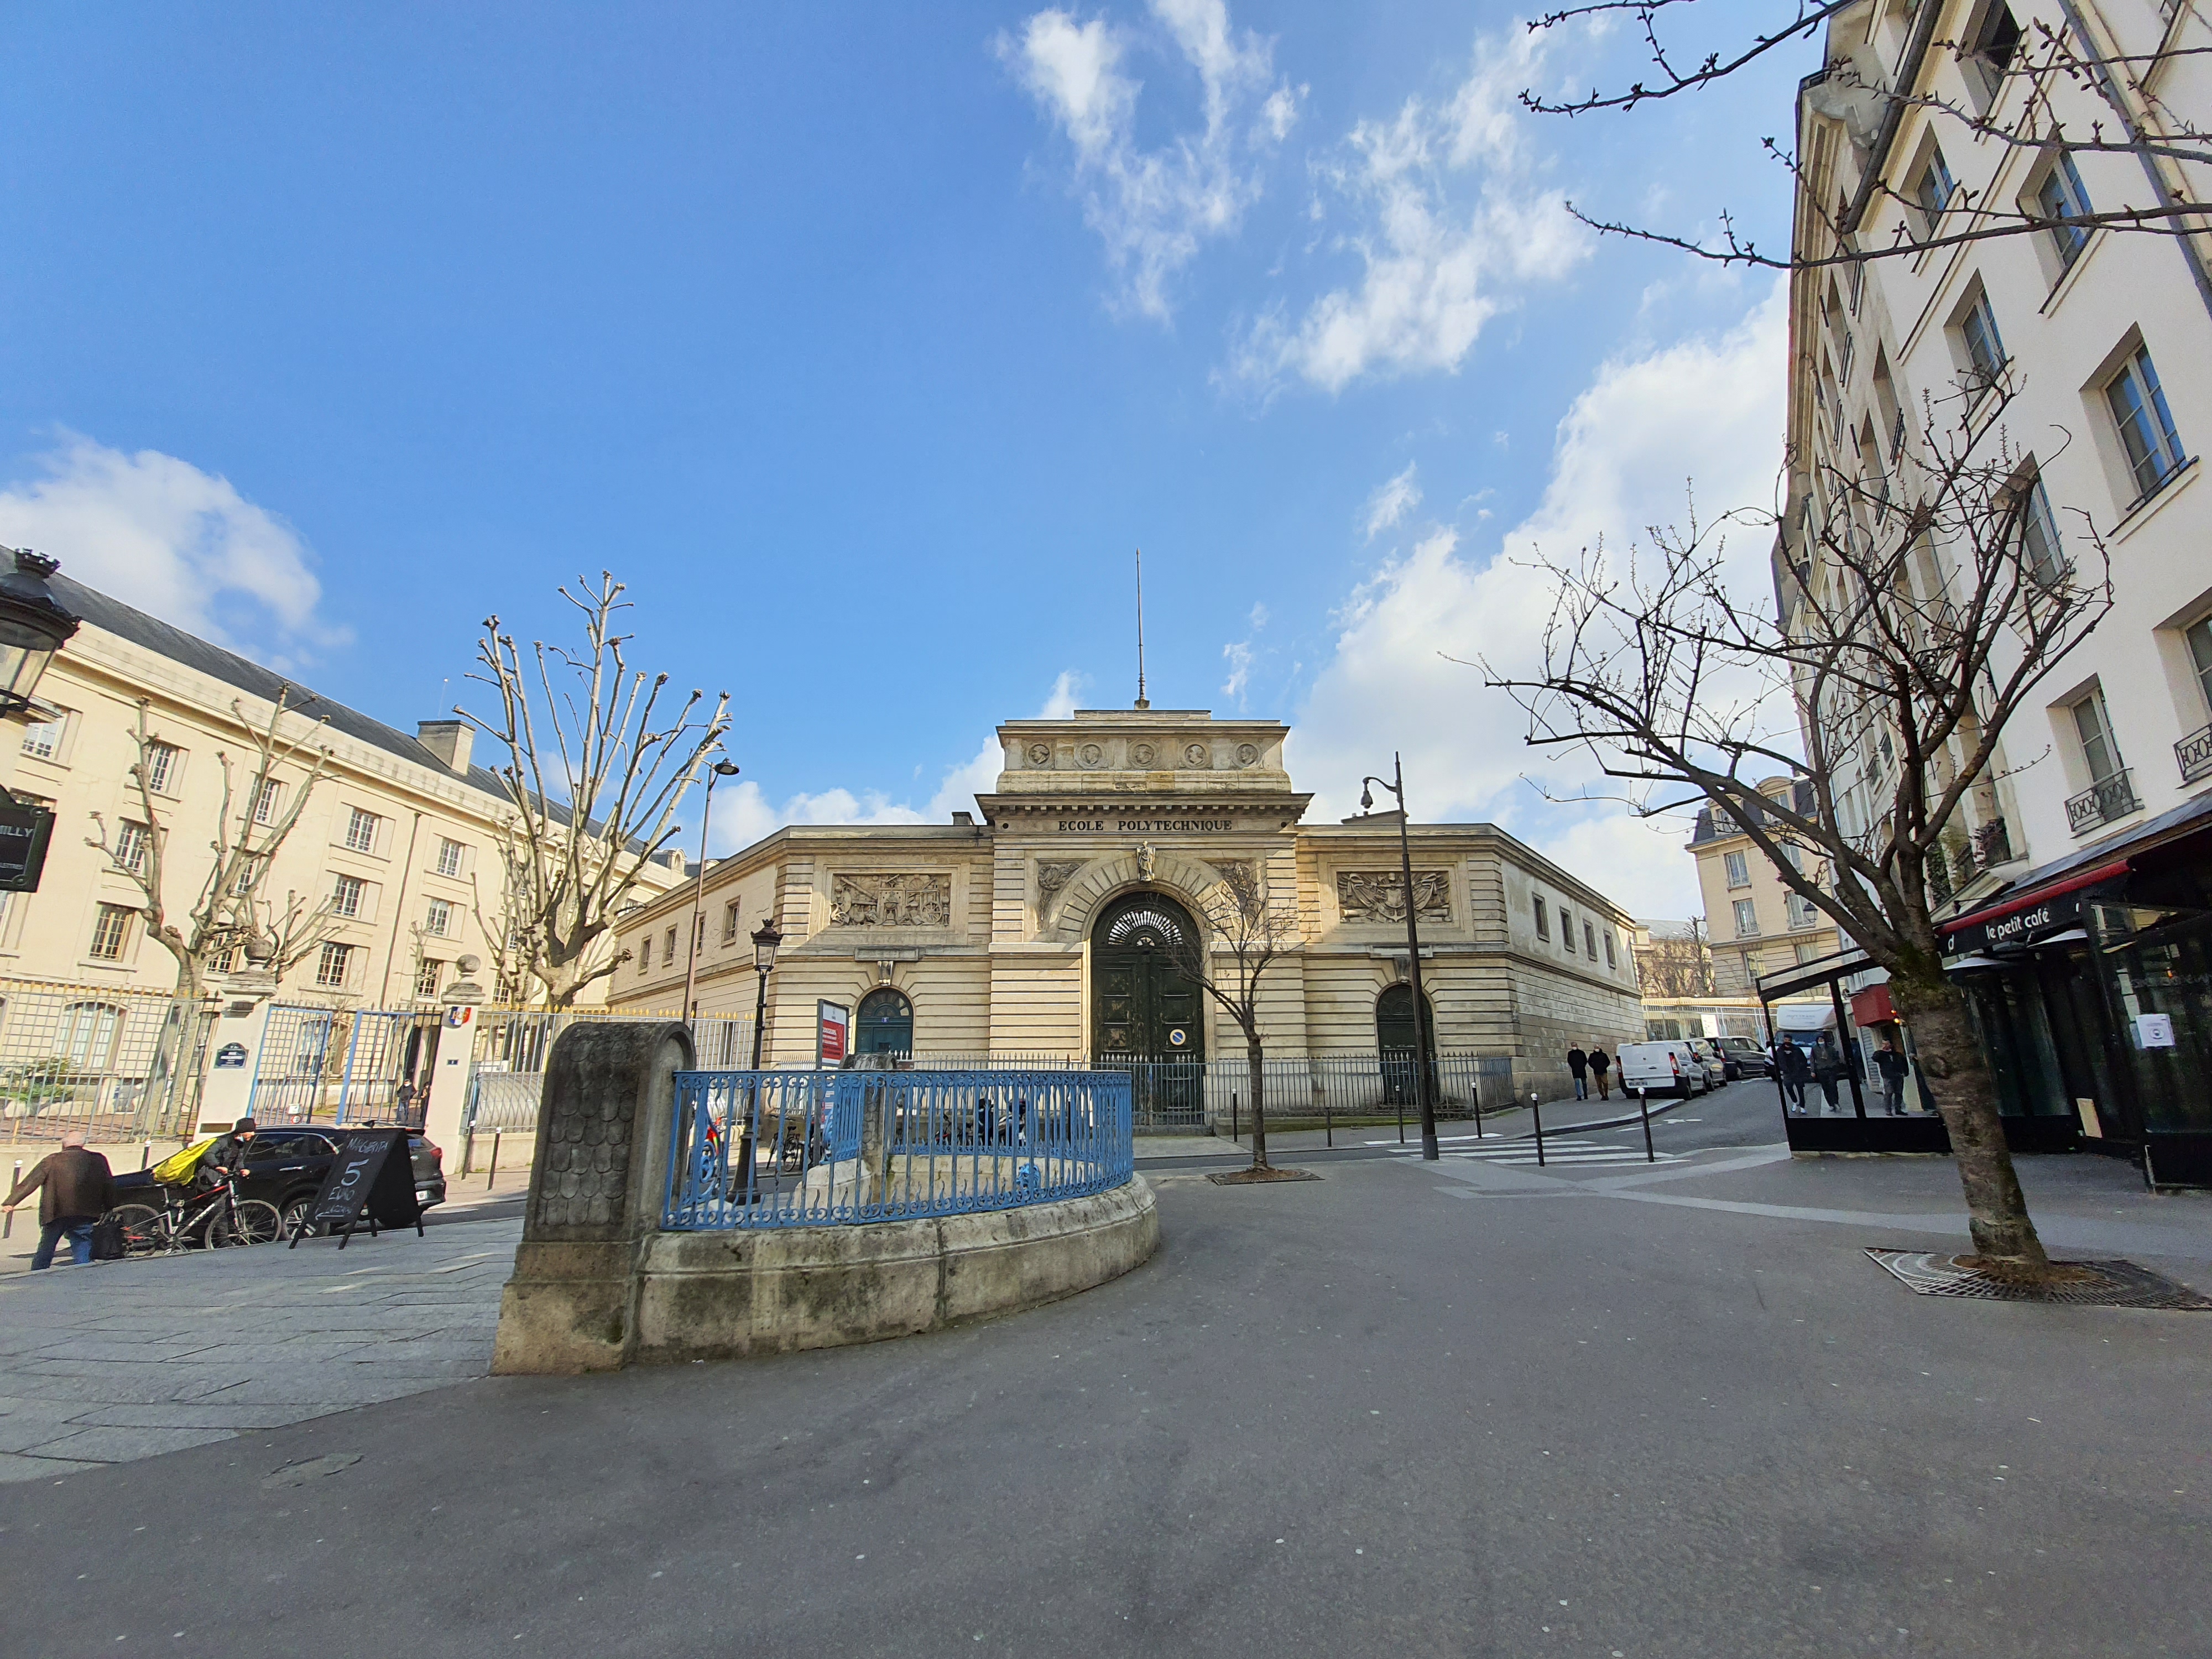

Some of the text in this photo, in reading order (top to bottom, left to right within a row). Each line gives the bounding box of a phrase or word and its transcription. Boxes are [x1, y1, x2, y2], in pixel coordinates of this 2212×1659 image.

[1058, 820, 1232, 832] ECOLE POLYTECHNIQUE
[1985, 907, 2051, 940] le petit café
[341, 1159, 370, 1186] 5
